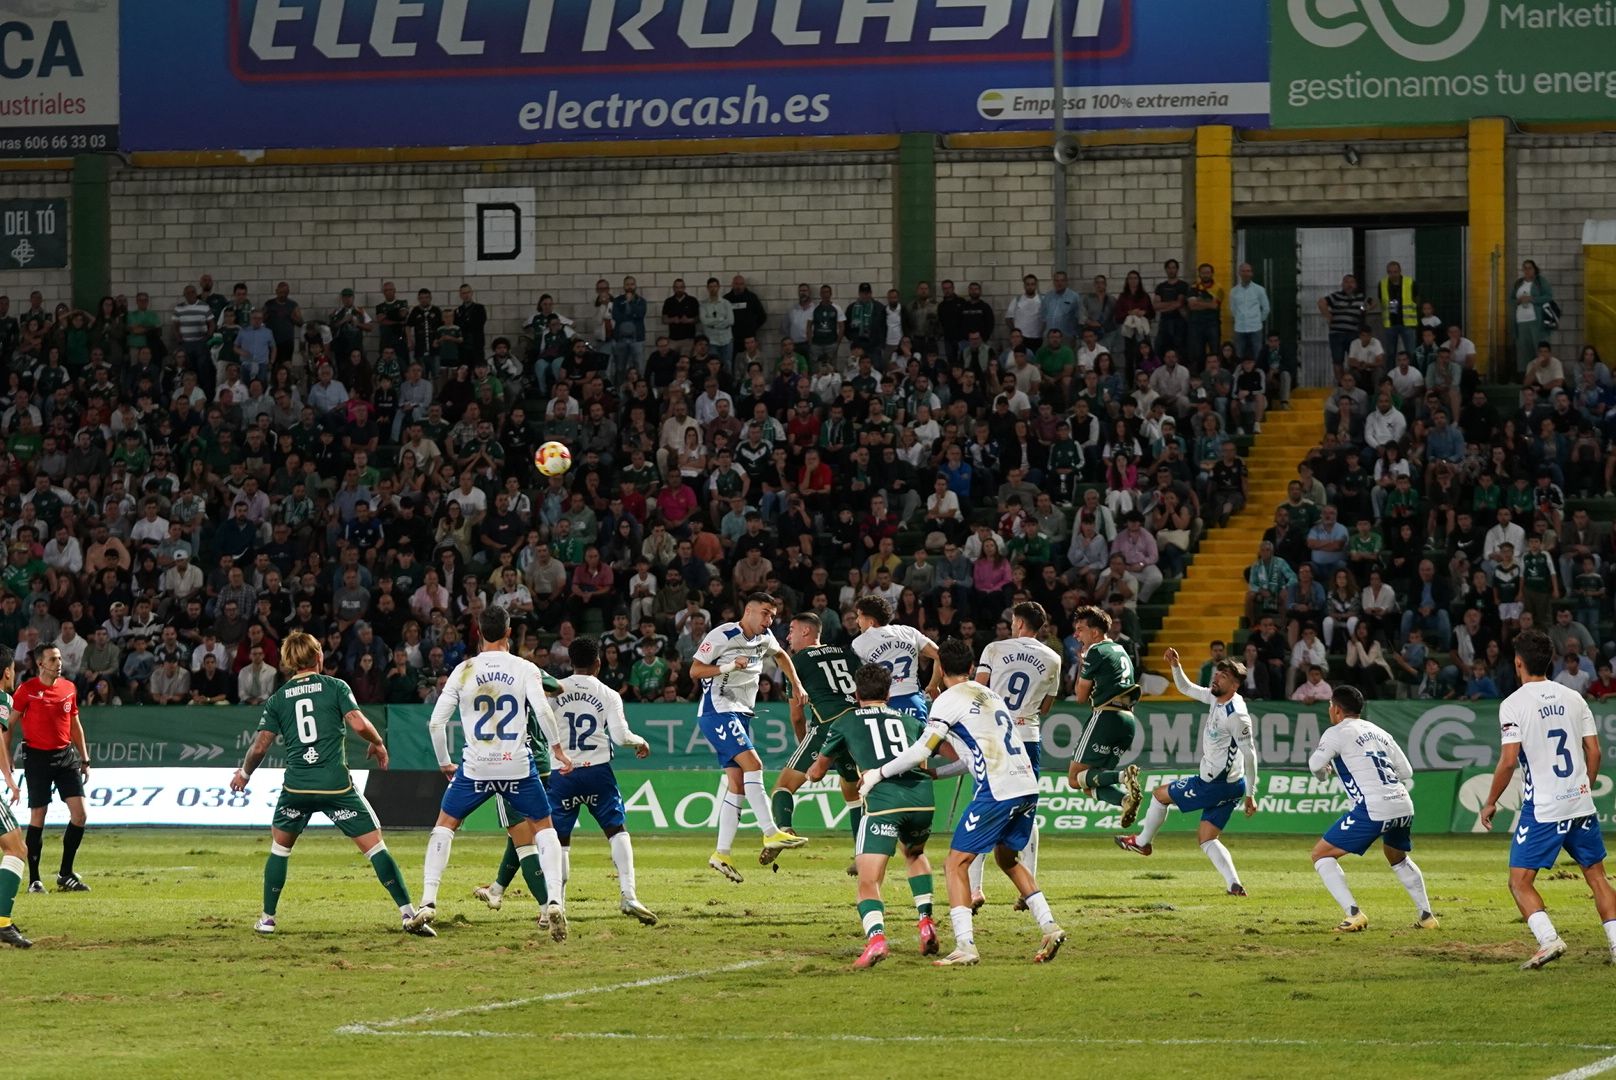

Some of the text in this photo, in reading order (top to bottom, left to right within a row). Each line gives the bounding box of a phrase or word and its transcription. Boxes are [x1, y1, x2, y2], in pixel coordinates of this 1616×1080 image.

[1500, 3, 1616, 28] Marketi
[1288, 71, 1490, 106] gestionamos
[1495, 69, 1526, 95] tu
[518, 84, 830, 131] electrocash.es
[1013, 91, 1229, 115] Empesa 100% extremeña
[25, 136, 48, 149] 606
[52, 136, 67, 149] 66
[71, 135, 87, 148] 33
[90, 135, 106, 147] 03
[5, 210, 32, 236] DEL
[477, 203, 521, 261] D
[868, 641, 892, 663] EREMY
[1002, 652, 1047, 676] DE MIGUEL
[475, 671, 515, 687] ÁLVARO
[817, 658, 857, 694] 15
[1003, 671, 1031, 711] 9
[295, 698, 318, 744] 6
[473, 693, 519, 741] 22
[1538, 704, 1565, 720] ZOILO
[563, 711, 598, 752] 12
[864, 717, 910, 761] 19
[994, 709, 1022, 756] 2
[1150, 713, 1321, 764] MCA
[86, 742, 168, 761] TUDENT
[1547, 727, 1574, 779] 3
[88, 786, 165, 808] 927
[175, 786, 252, 808] 038
[474, 780, 520, 794] EAVE
[561, 794, 600, 811] EAVE
[1054, 814, 1088, 829] 63
